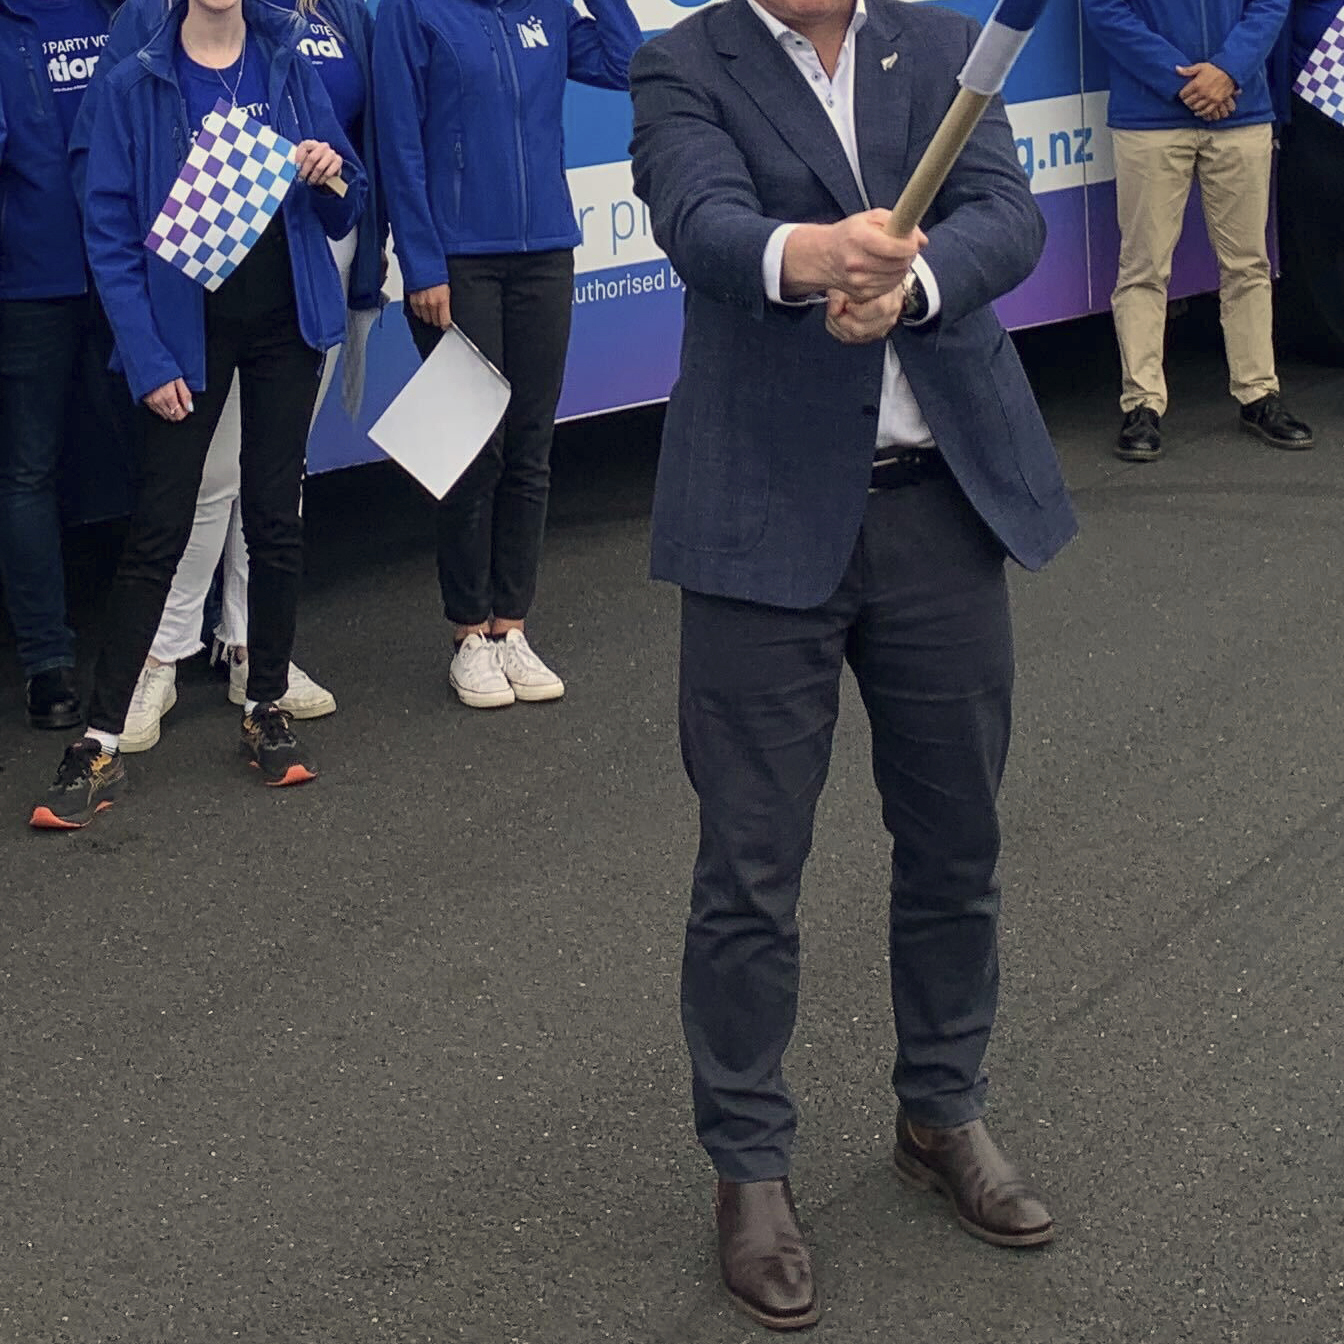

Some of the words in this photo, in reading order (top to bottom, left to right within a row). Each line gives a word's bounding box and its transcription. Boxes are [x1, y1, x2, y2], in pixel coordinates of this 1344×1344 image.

[48, 37, 89, 54] PARTY
[90, 34, 110, 48] VO
[310, 23, 333, 36] OTE
[1014, 127, 1093, 179] g.nz
[572, 267, 665, 305] uthorised
